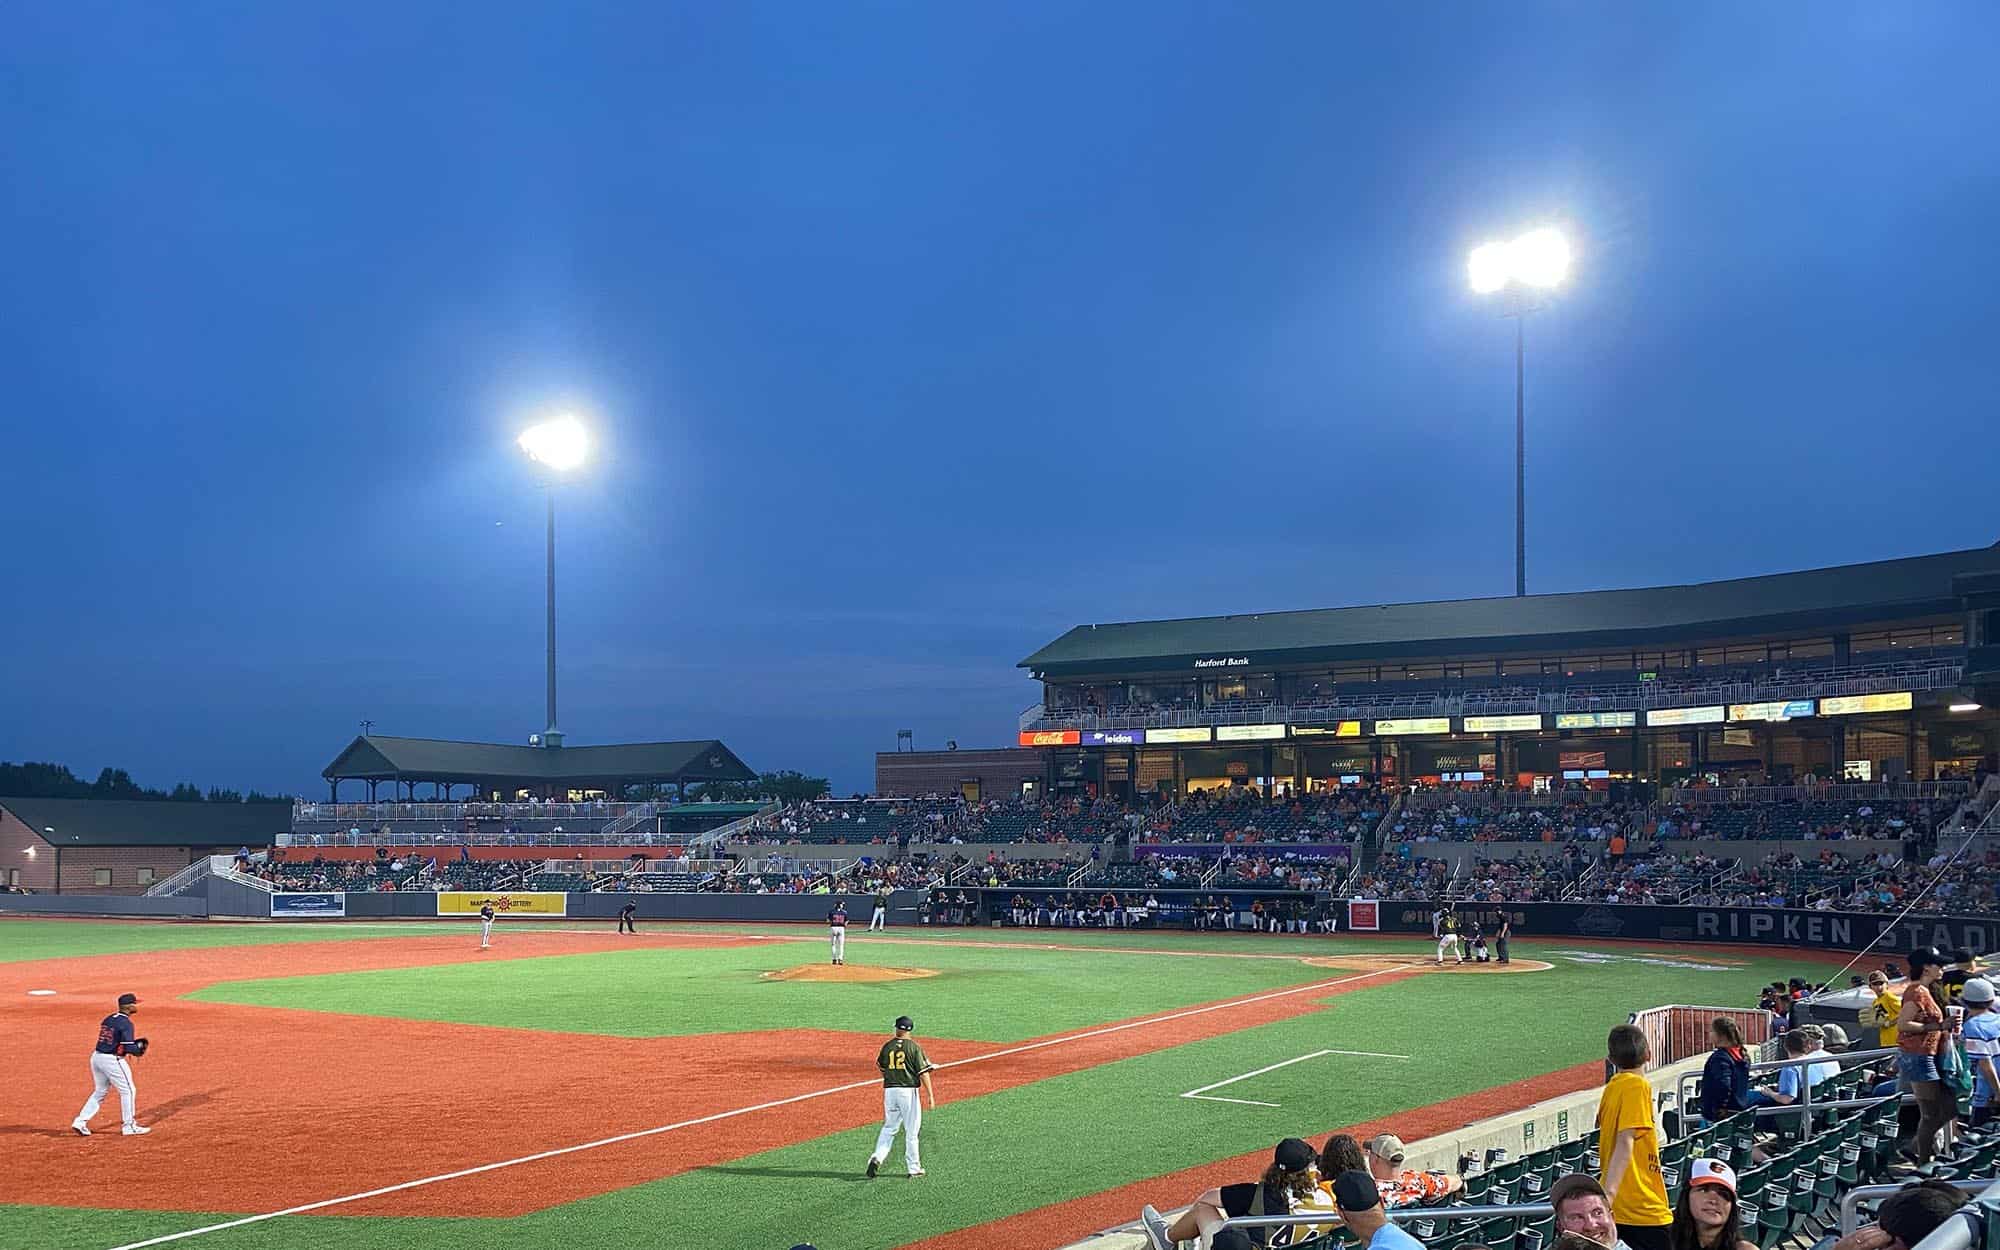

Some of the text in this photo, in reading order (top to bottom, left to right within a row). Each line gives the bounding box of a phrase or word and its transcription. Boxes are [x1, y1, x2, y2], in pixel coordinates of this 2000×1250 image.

[1194, 657, 1249, 668] Harford Bank
[1104, 733, 1133, 744] leidos
[1696, 911, 1850, 945] RIPKEN
[888, 1050, 906, 1070] 12
